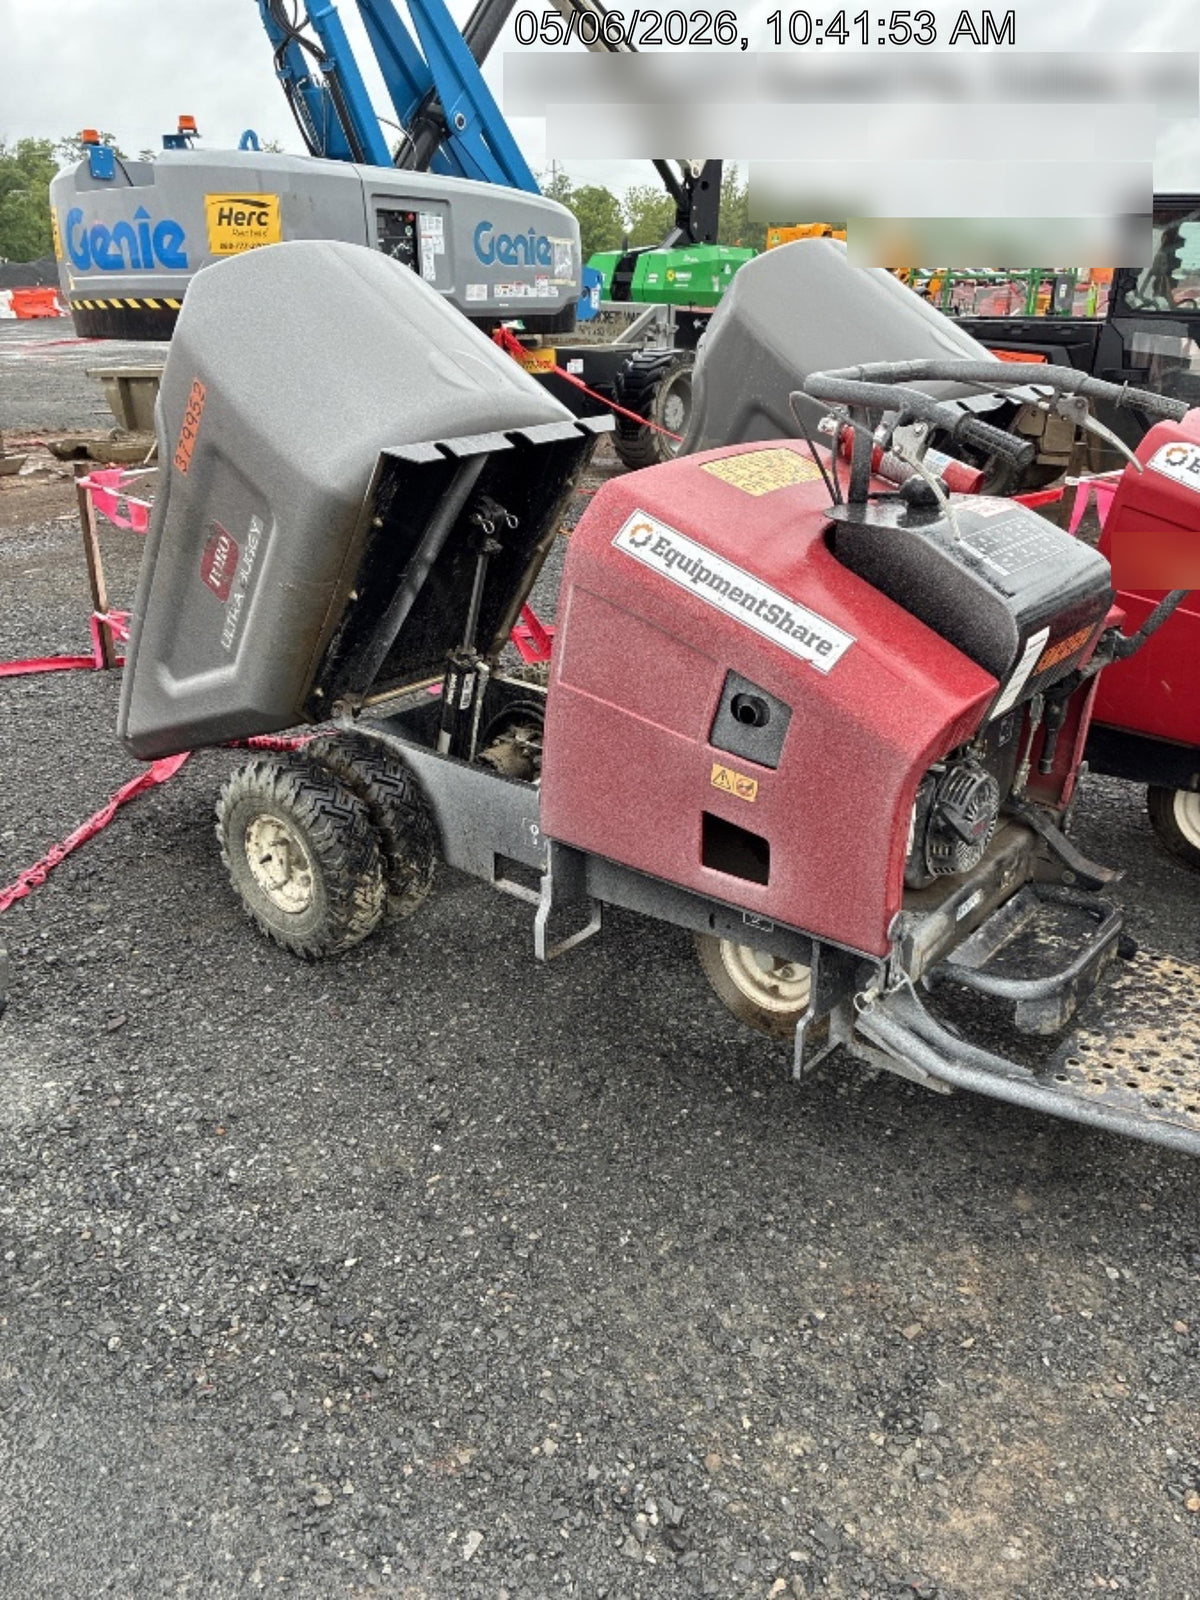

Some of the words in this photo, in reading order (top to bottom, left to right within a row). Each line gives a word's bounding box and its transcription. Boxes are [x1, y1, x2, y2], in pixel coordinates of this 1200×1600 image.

[66, 205, 188, 271] Genie
[217, 207, 269, 227] Herc
[474, 219, 552, 266] Genie
[175, 381, 205, 472] 379952
[208, 536, 231, 588] TORO
[220, 592, 245, 651] ULTRA
[650, 536, 833, 657] EquipmentShare
